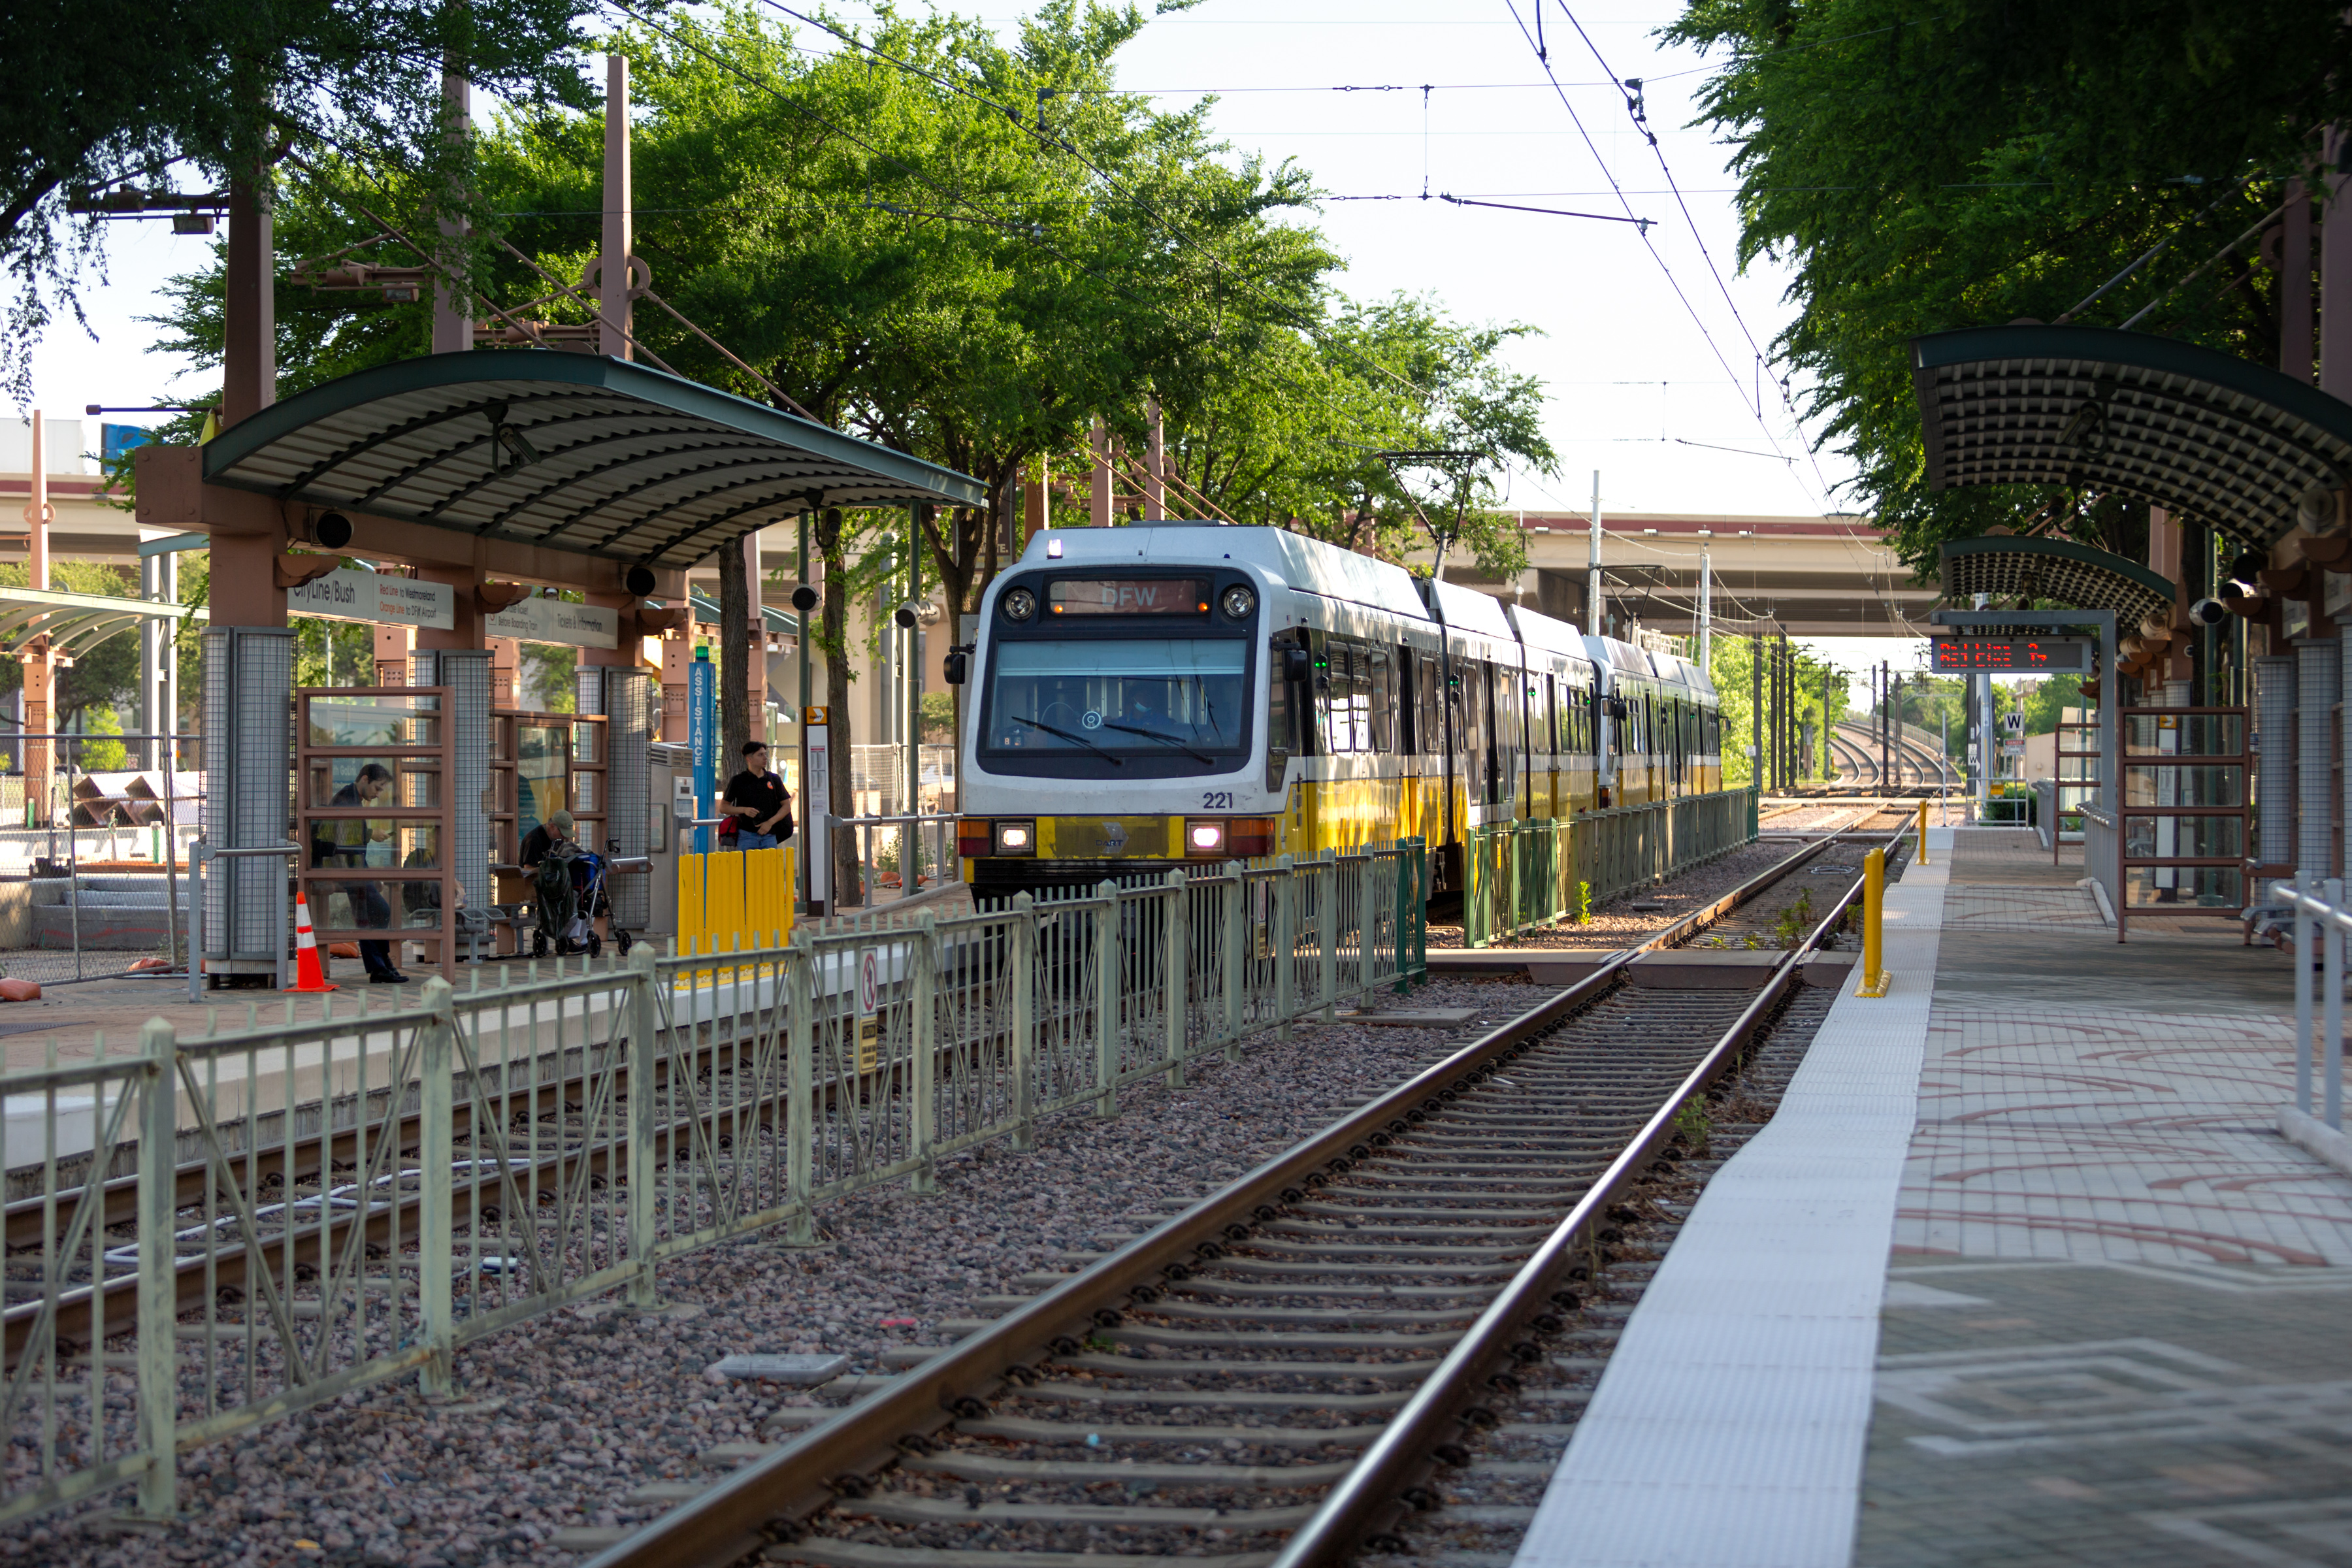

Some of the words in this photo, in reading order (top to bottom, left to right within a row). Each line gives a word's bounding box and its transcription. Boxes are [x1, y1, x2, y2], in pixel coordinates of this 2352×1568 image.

[380, 583, 389, 596] Red
[389, 585, 399, 596] Line
[400, 587, 404, 598] to
[405, 587, 436, 601] Westmoreland
[1102, 587, 1158, 607] DFW
[380, 600, 395, 615] Orange
[396, 603, 405, 615] Line
[406, 605, 411, 616] to
[422, 606, 436, 620] Airport
[498, 615, 510, 627] Before
[511, 617, 529, 632] Boarding
[529, 620, 538, 631] Train
[557, 613, 572, 629] Tickets
[573, 615, 577, 630] &
[578, 616, 602, 632] Information
[694, 667, 703, 766] ASSISTANCE
[2006, 715, 2021, 729] W
[1203, 791, 1233, 809] 221
